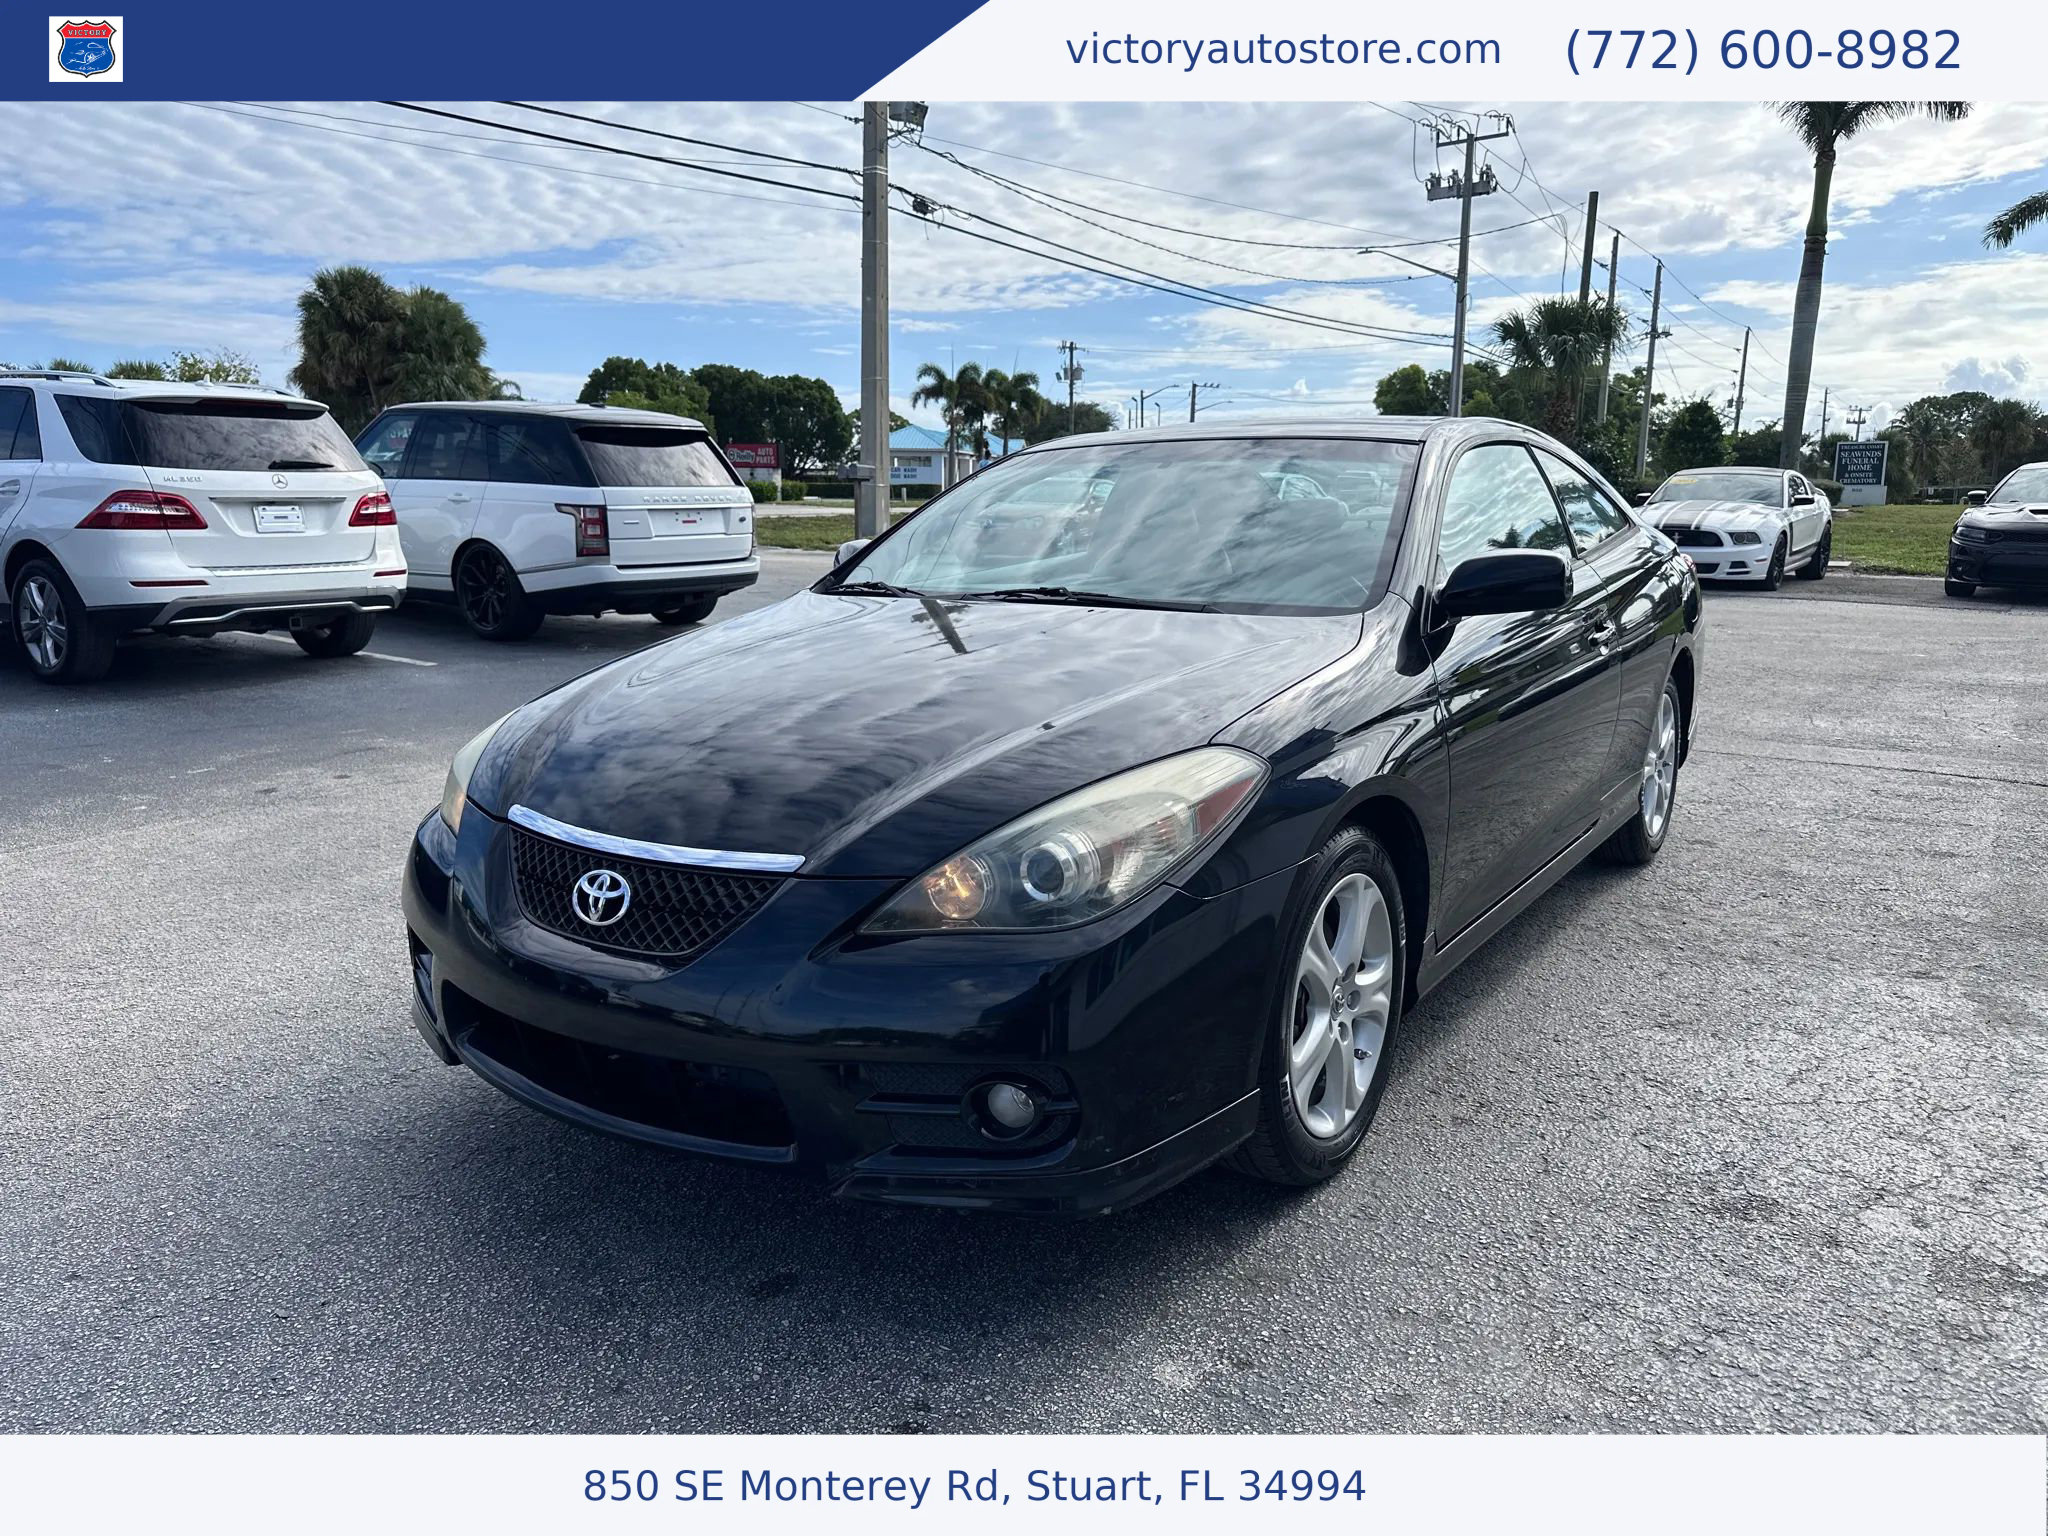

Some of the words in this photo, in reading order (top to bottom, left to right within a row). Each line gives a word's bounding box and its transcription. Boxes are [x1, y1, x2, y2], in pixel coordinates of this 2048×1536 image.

[757, 447, 774, 456] AUTO
[756, 456, 775, 464] PARTS
[643, 495, 687, 503] RANGE
